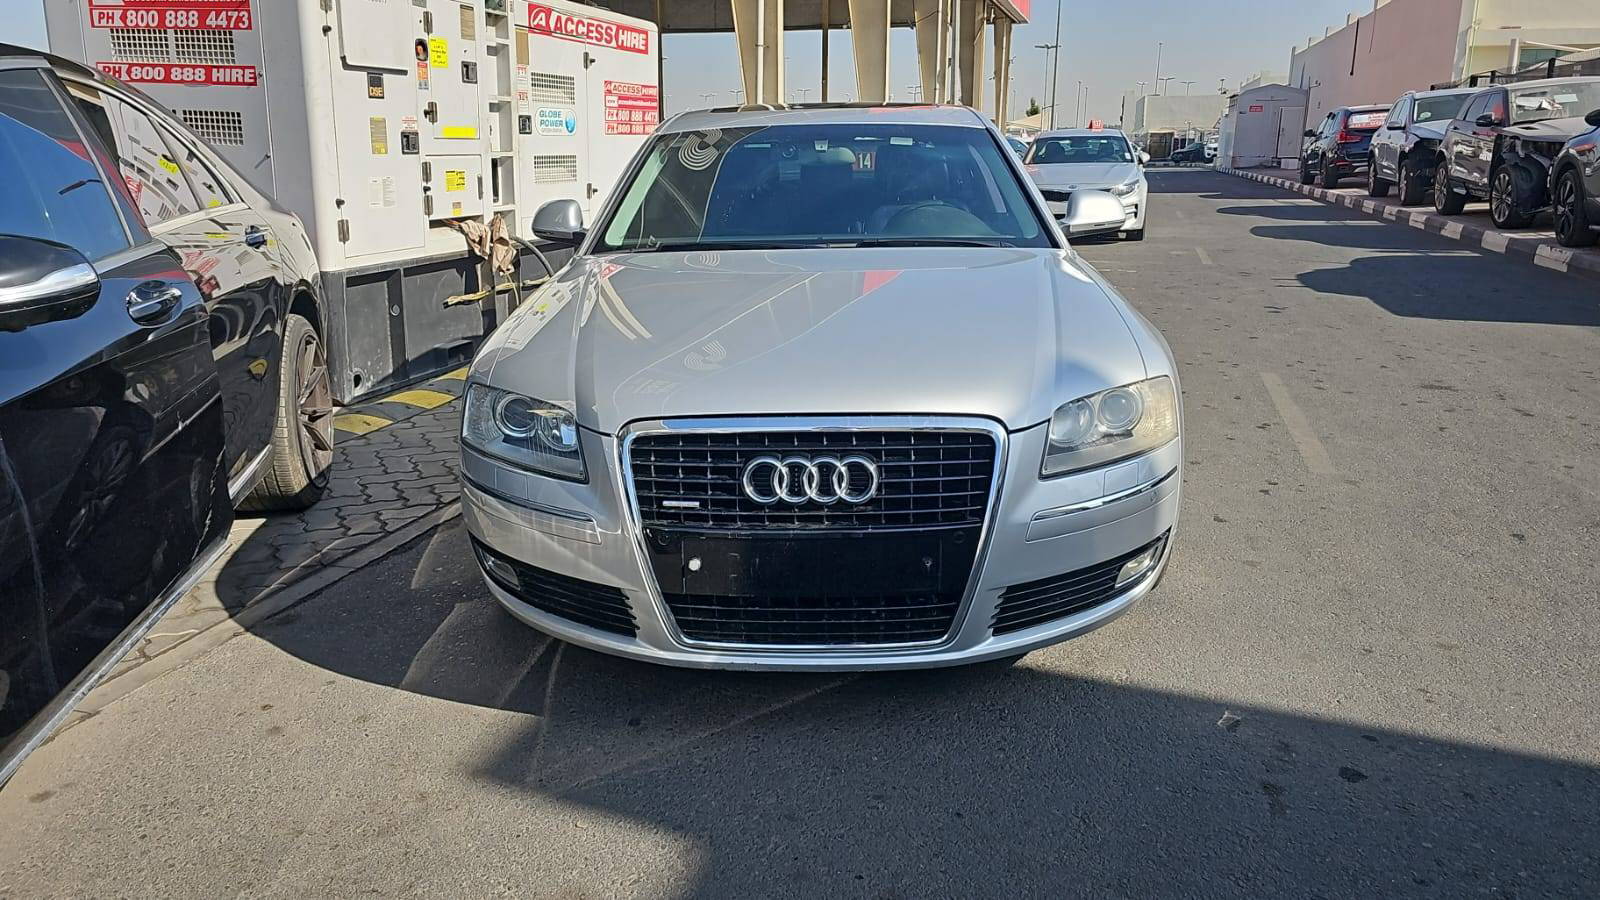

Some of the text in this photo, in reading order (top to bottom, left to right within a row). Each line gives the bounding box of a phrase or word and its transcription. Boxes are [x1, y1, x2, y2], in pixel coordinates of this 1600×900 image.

[126, 10, 159, 27] 800
[165, 10, 199, 28] 888
[206, 11, 249, 29] 4473
[554, 15, 614, 44] ACCESS
[618, 29, 646, 50] HIRE
[130, 66, 165, 81] 800
[170, 67, 206, 82] 888
[212, 69, 255, 83] HIRE
[369, 86, 383, 96] DSE
[612, 84, 641, 95] ACCESS
[539, 109, 562, 118] GLOBE
[539, 119, 564, 128] POWER
[858, 152, 871, 169] 14
